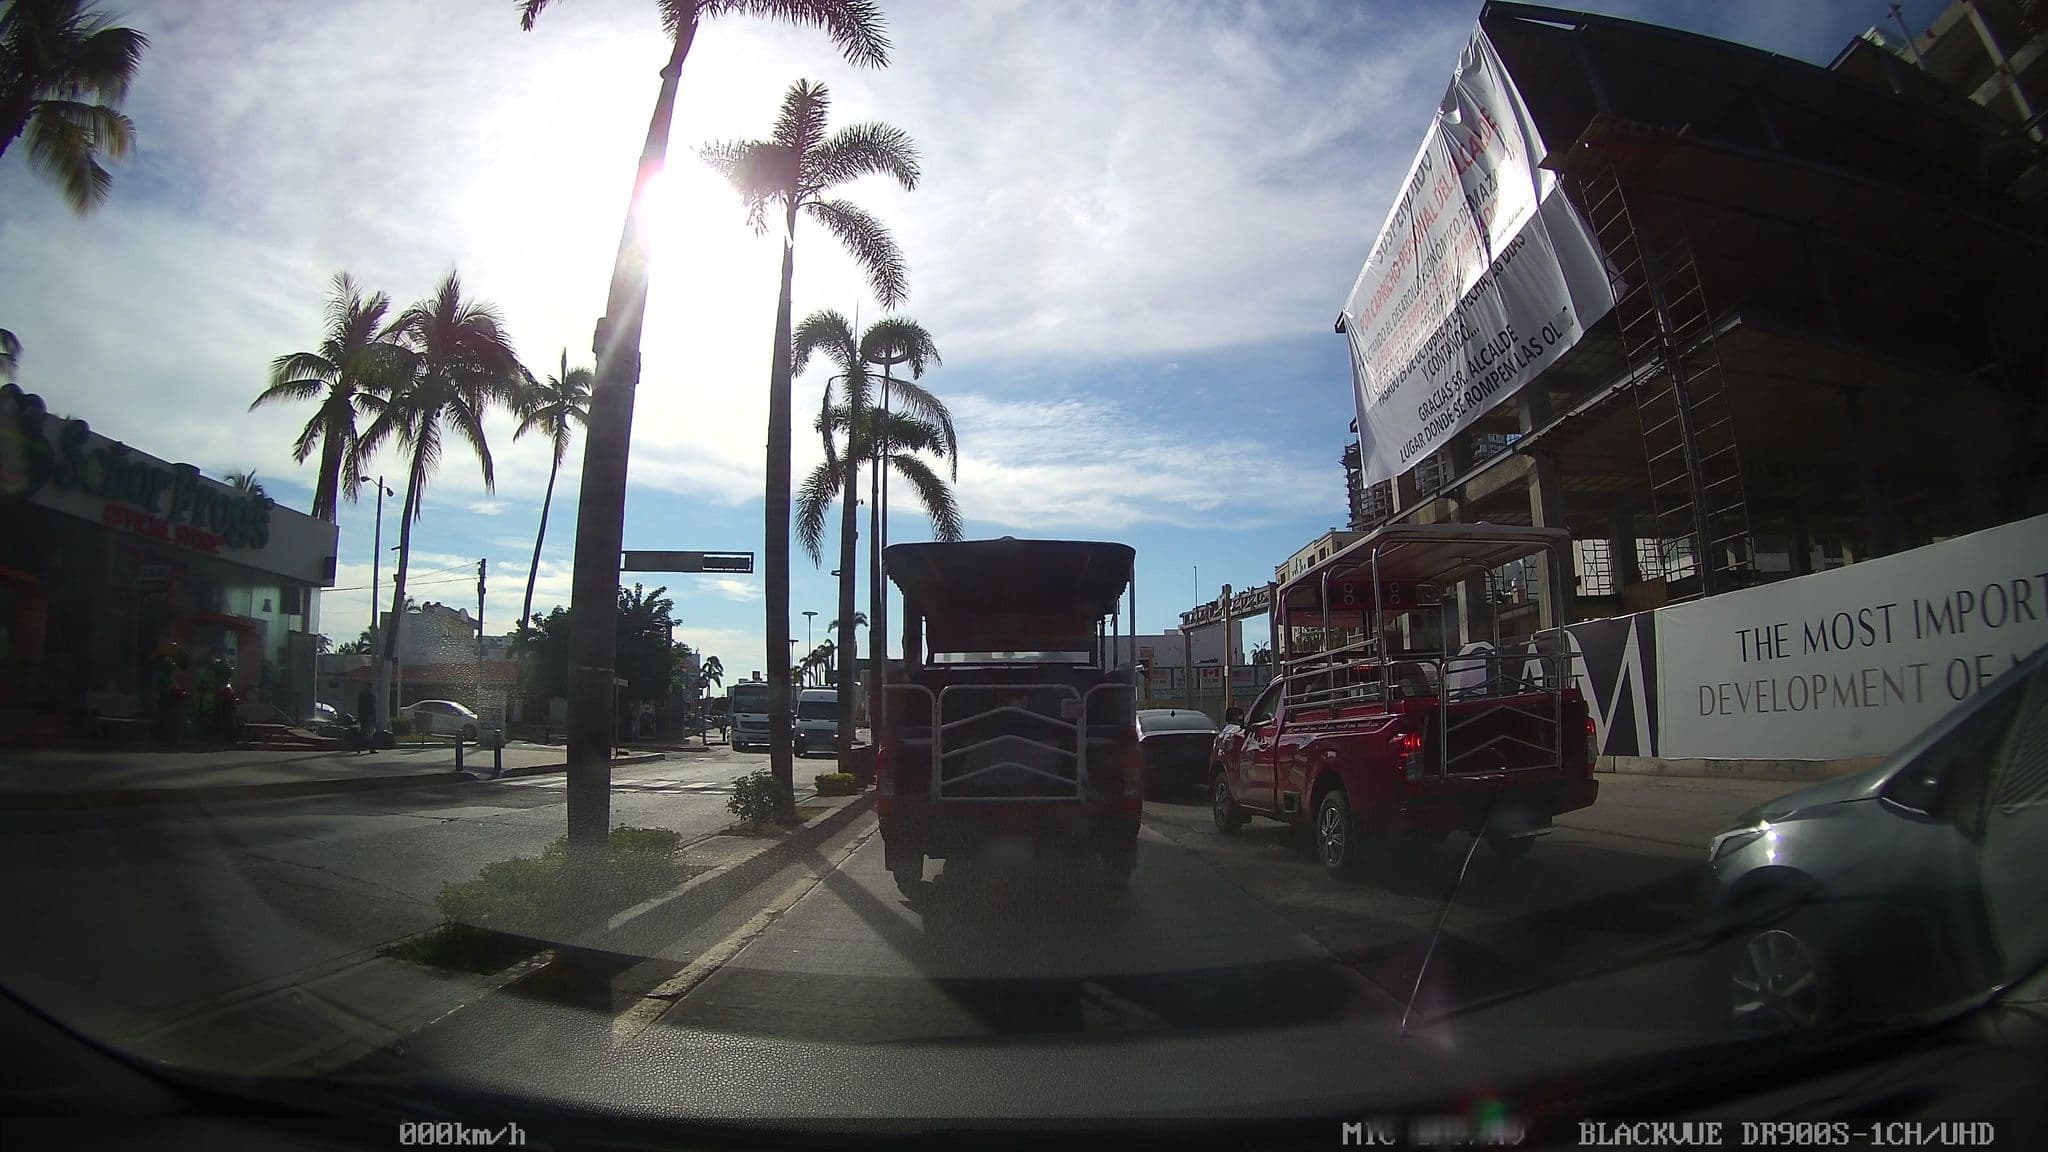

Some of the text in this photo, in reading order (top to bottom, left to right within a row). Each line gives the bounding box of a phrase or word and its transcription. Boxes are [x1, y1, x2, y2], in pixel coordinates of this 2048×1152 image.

[1370, 259, 1401, 319] CAPRICHO
[1399, 200, 1438, 272] PERSONAL
[1434, 175, 1453, 210] DEL
[1385, 316, 1393, 336] EL
[1413, 322, 1445, 366] OCTUBRE
[1400, 436, 1426, 464] LUGAR
[1424, 411, 1454, 442] DONDE
[1454, 400, 1467, 419] SE
[1464, 364, 1517, 408] ROMPEN
[1514, 337, 1543, 370] LAS
[1418, 381, 1454, 422] GRACIAS
[1453, 370, 1468, 393] SR.
[1468, 324, 1519, 378] ALCALDE
[1735, 623, 1790, 663] THE
[1804, 603, 1896, 655] MOST
[1700, 654, 1993, 716] DEVELOPMENT OF
